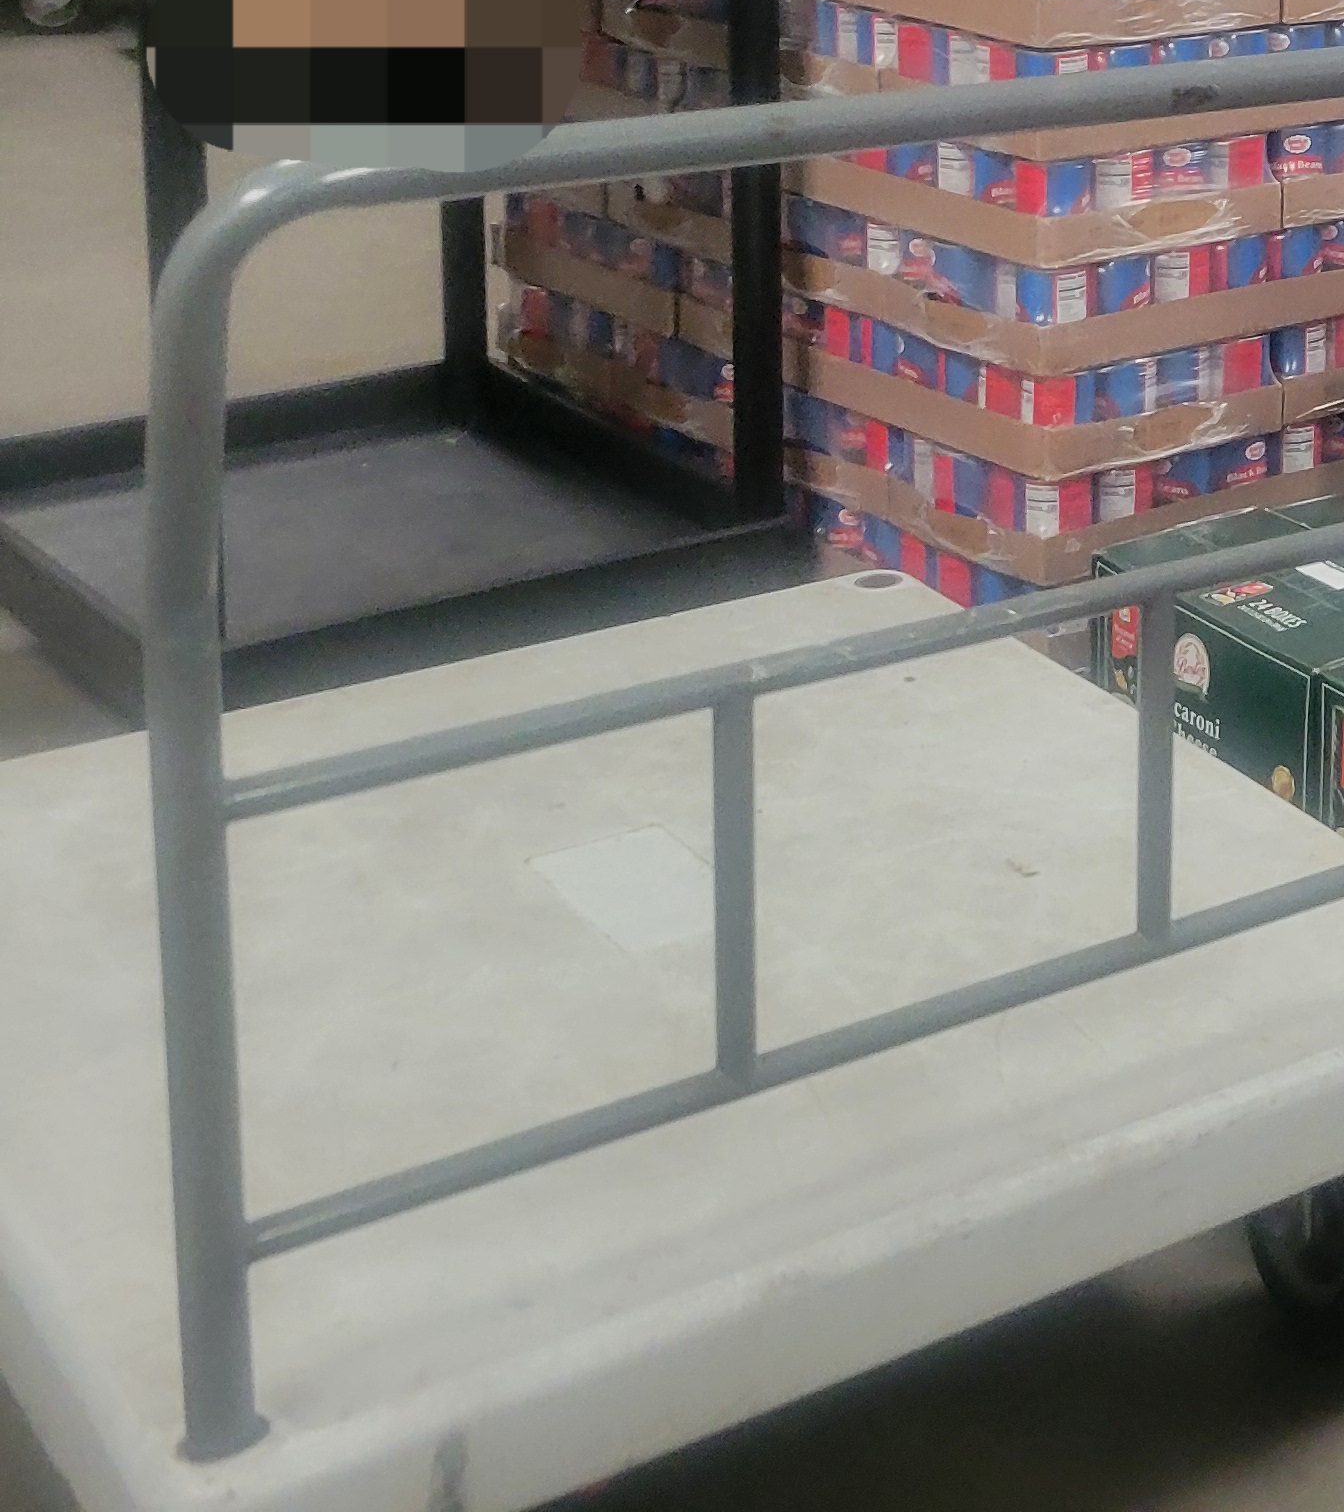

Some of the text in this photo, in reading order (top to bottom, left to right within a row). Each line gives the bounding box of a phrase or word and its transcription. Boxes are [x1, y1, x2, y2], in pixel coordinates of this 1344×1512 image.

[1249, 599, 1307, 629] 24 BOXES
[1174, 701, 1222, 741] caroni
